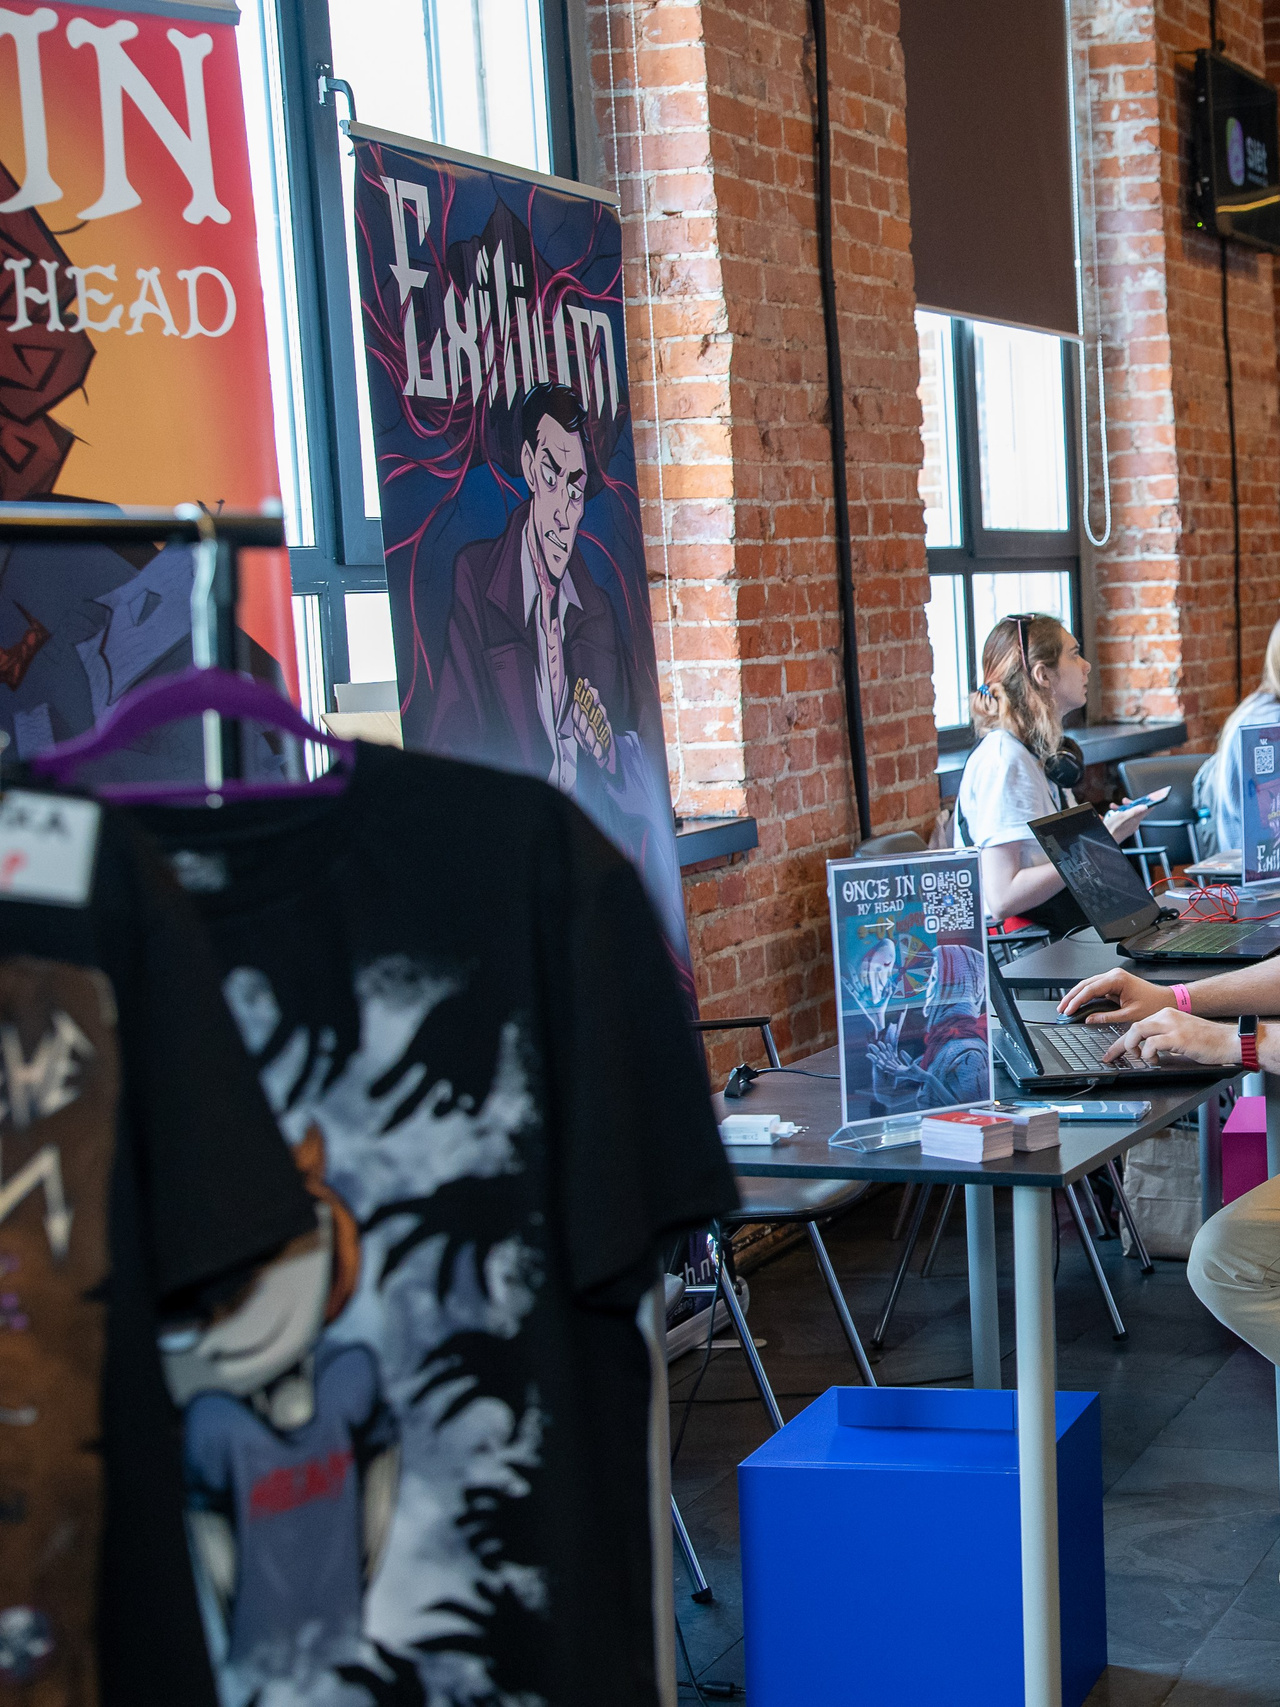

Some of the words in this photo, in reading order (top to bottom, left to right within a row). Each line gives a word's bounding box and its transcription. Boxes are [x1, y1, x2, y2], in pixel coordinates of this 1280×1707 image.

[4, 258, 237, 339] HEAD
[380, 175, 619, 421] Exilium
[842, 878, 891, 902] ONCE
[895, 875, 916, 898] IN
[856, 902, 872, 916] MY
[874, 898, 905, 914] HEAD
